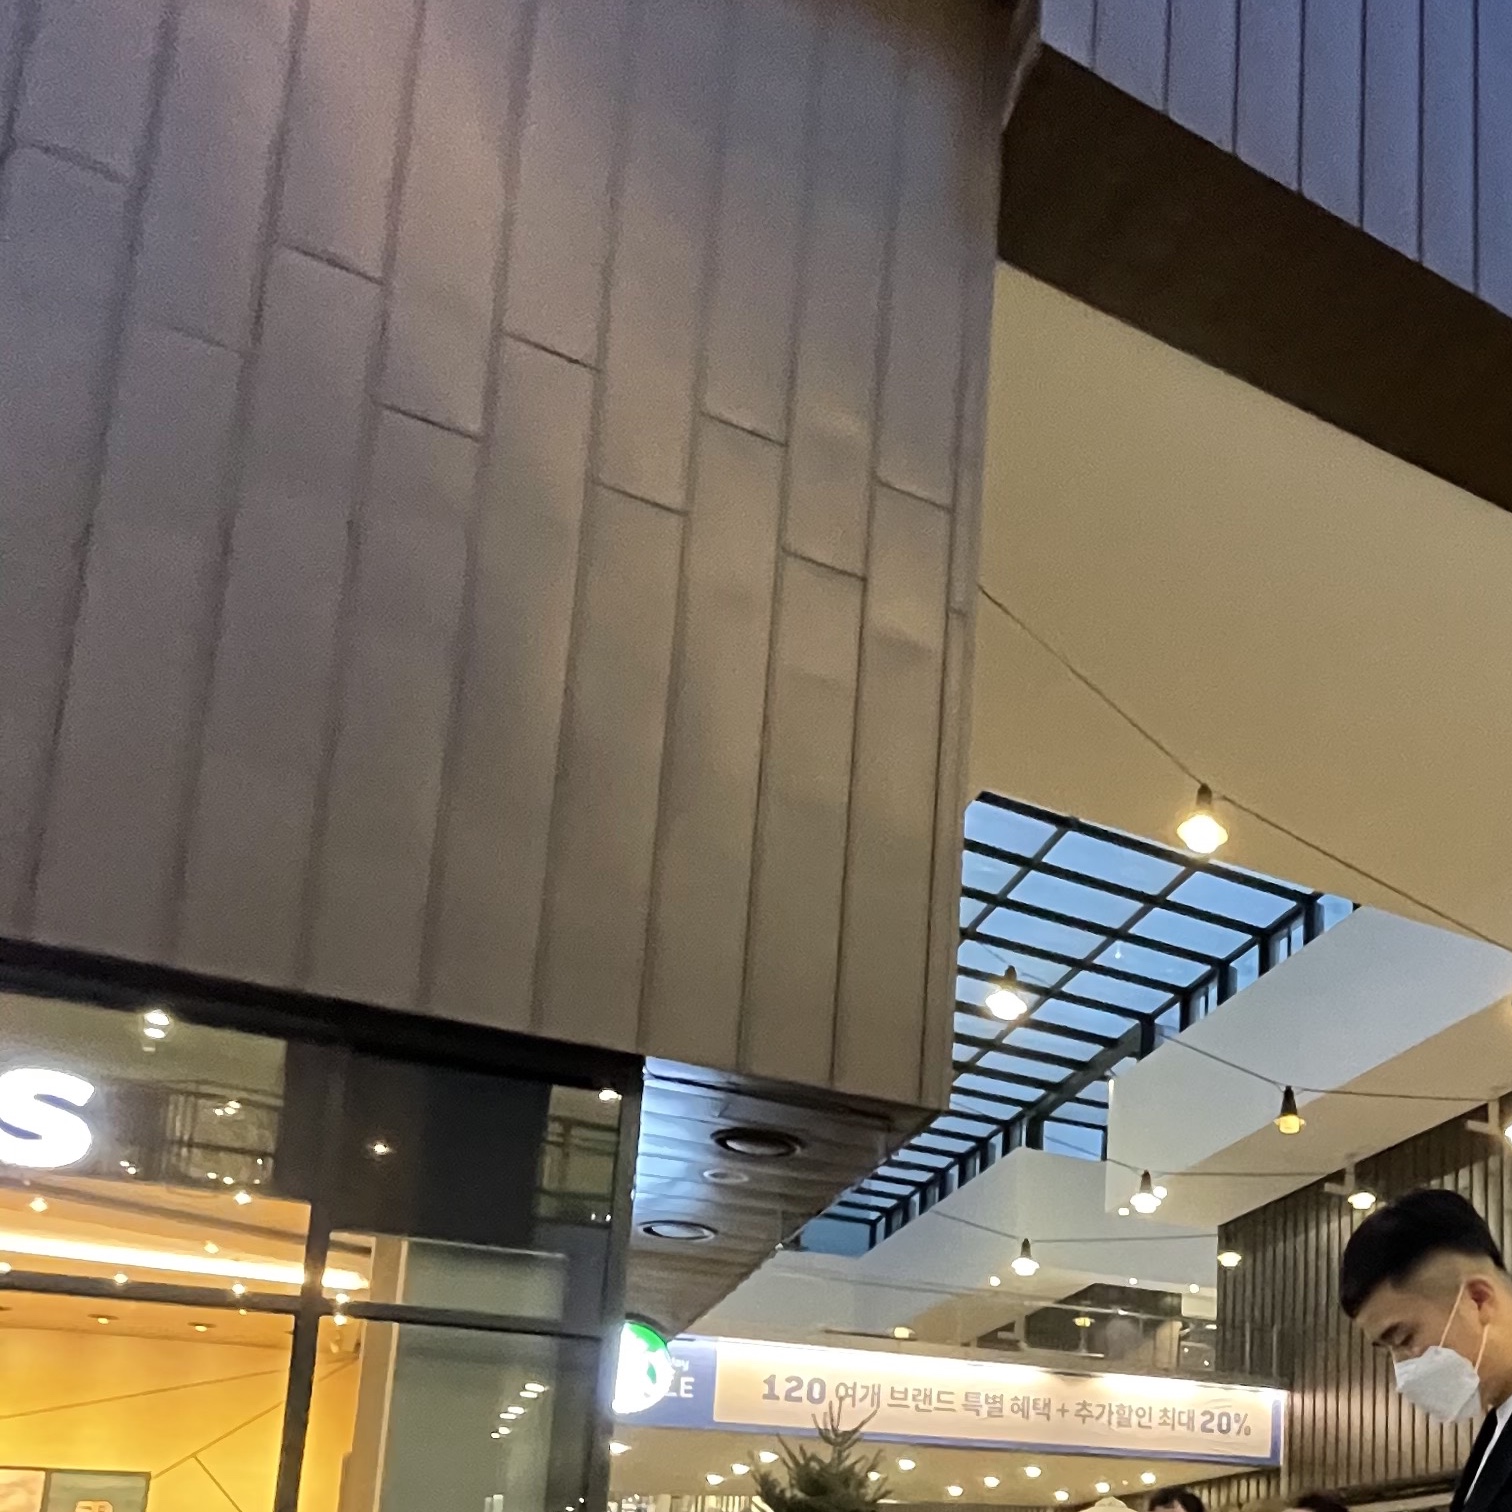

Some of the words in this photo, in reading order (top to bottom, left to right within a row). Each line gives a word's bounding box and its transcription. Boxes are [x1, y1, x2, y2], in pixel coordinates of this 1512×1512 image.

[762, 1374, 827, 1405] 120
[835, 1381, 881, 1409] 여개
[887, 1386, 957, 1413] 브랜드
[962, 1391, 1004, 1419] 특별
[1010, 1395, 1051, 1421] 혜택
[1074, 1400, 1152, 1430] 추가할인
[1158, 1407, 1195, 1432] 최대
[1200, 1410, 1252, 1437] 20%
